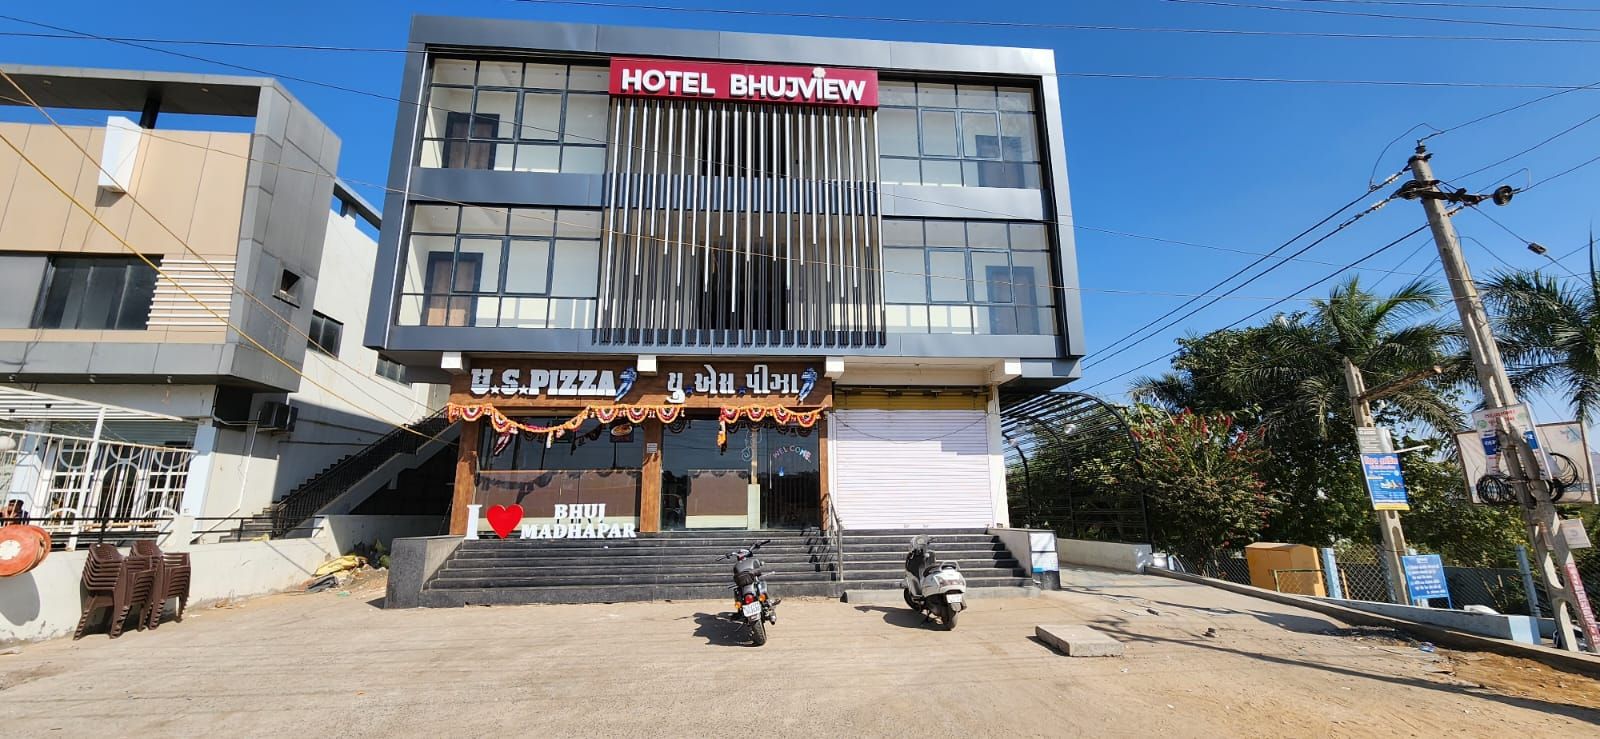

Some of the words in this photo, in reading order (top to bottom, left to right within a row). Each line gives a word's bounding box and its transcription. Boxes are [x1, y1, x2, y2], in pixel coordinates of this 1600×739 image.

[621, 68, 716, 95] HOTEL
[730, 67, 867, 102] BHUJVIEW
[772, 445, 812, 463] WELCOME
[463, 504, 483, 540] I
[554, 503, 606, 522] BHUJ
[519, 522, 637, 540] MADHAPAR
